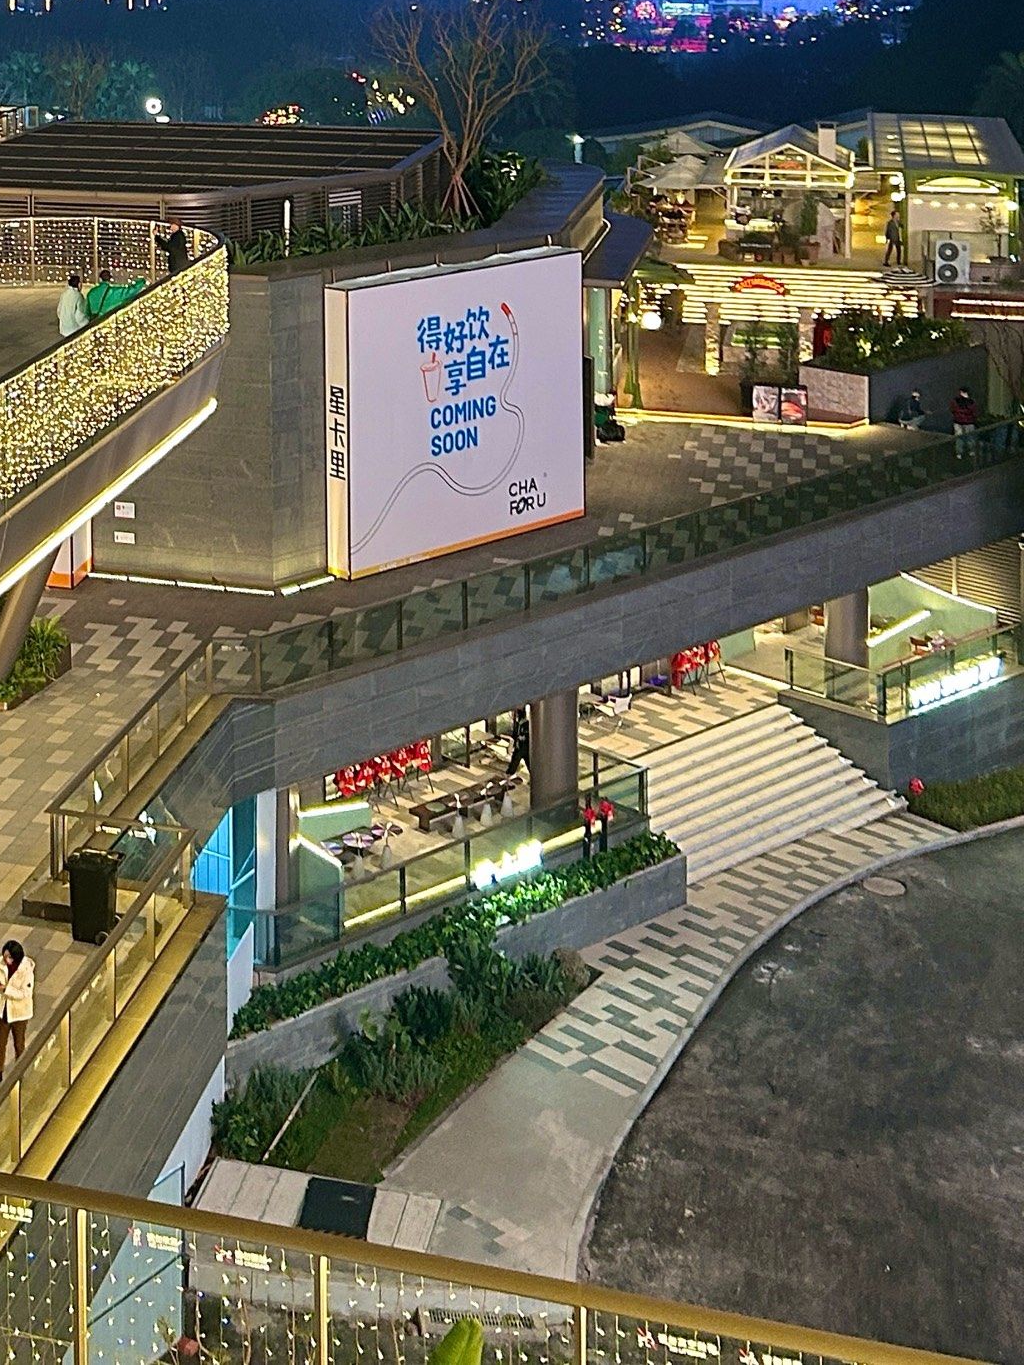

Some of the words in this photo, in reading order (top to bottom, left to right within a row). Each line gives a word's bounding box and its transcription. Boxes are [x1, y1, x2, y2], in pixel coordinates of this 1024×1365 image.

[417, 306, 490, 355] 得好饮
[444, 335, 510, 396] 享自在
[431, 395, 496, 429] COMING
[431, 427, 478, 457] SOON
[509, 477, 538, 497] CHA
